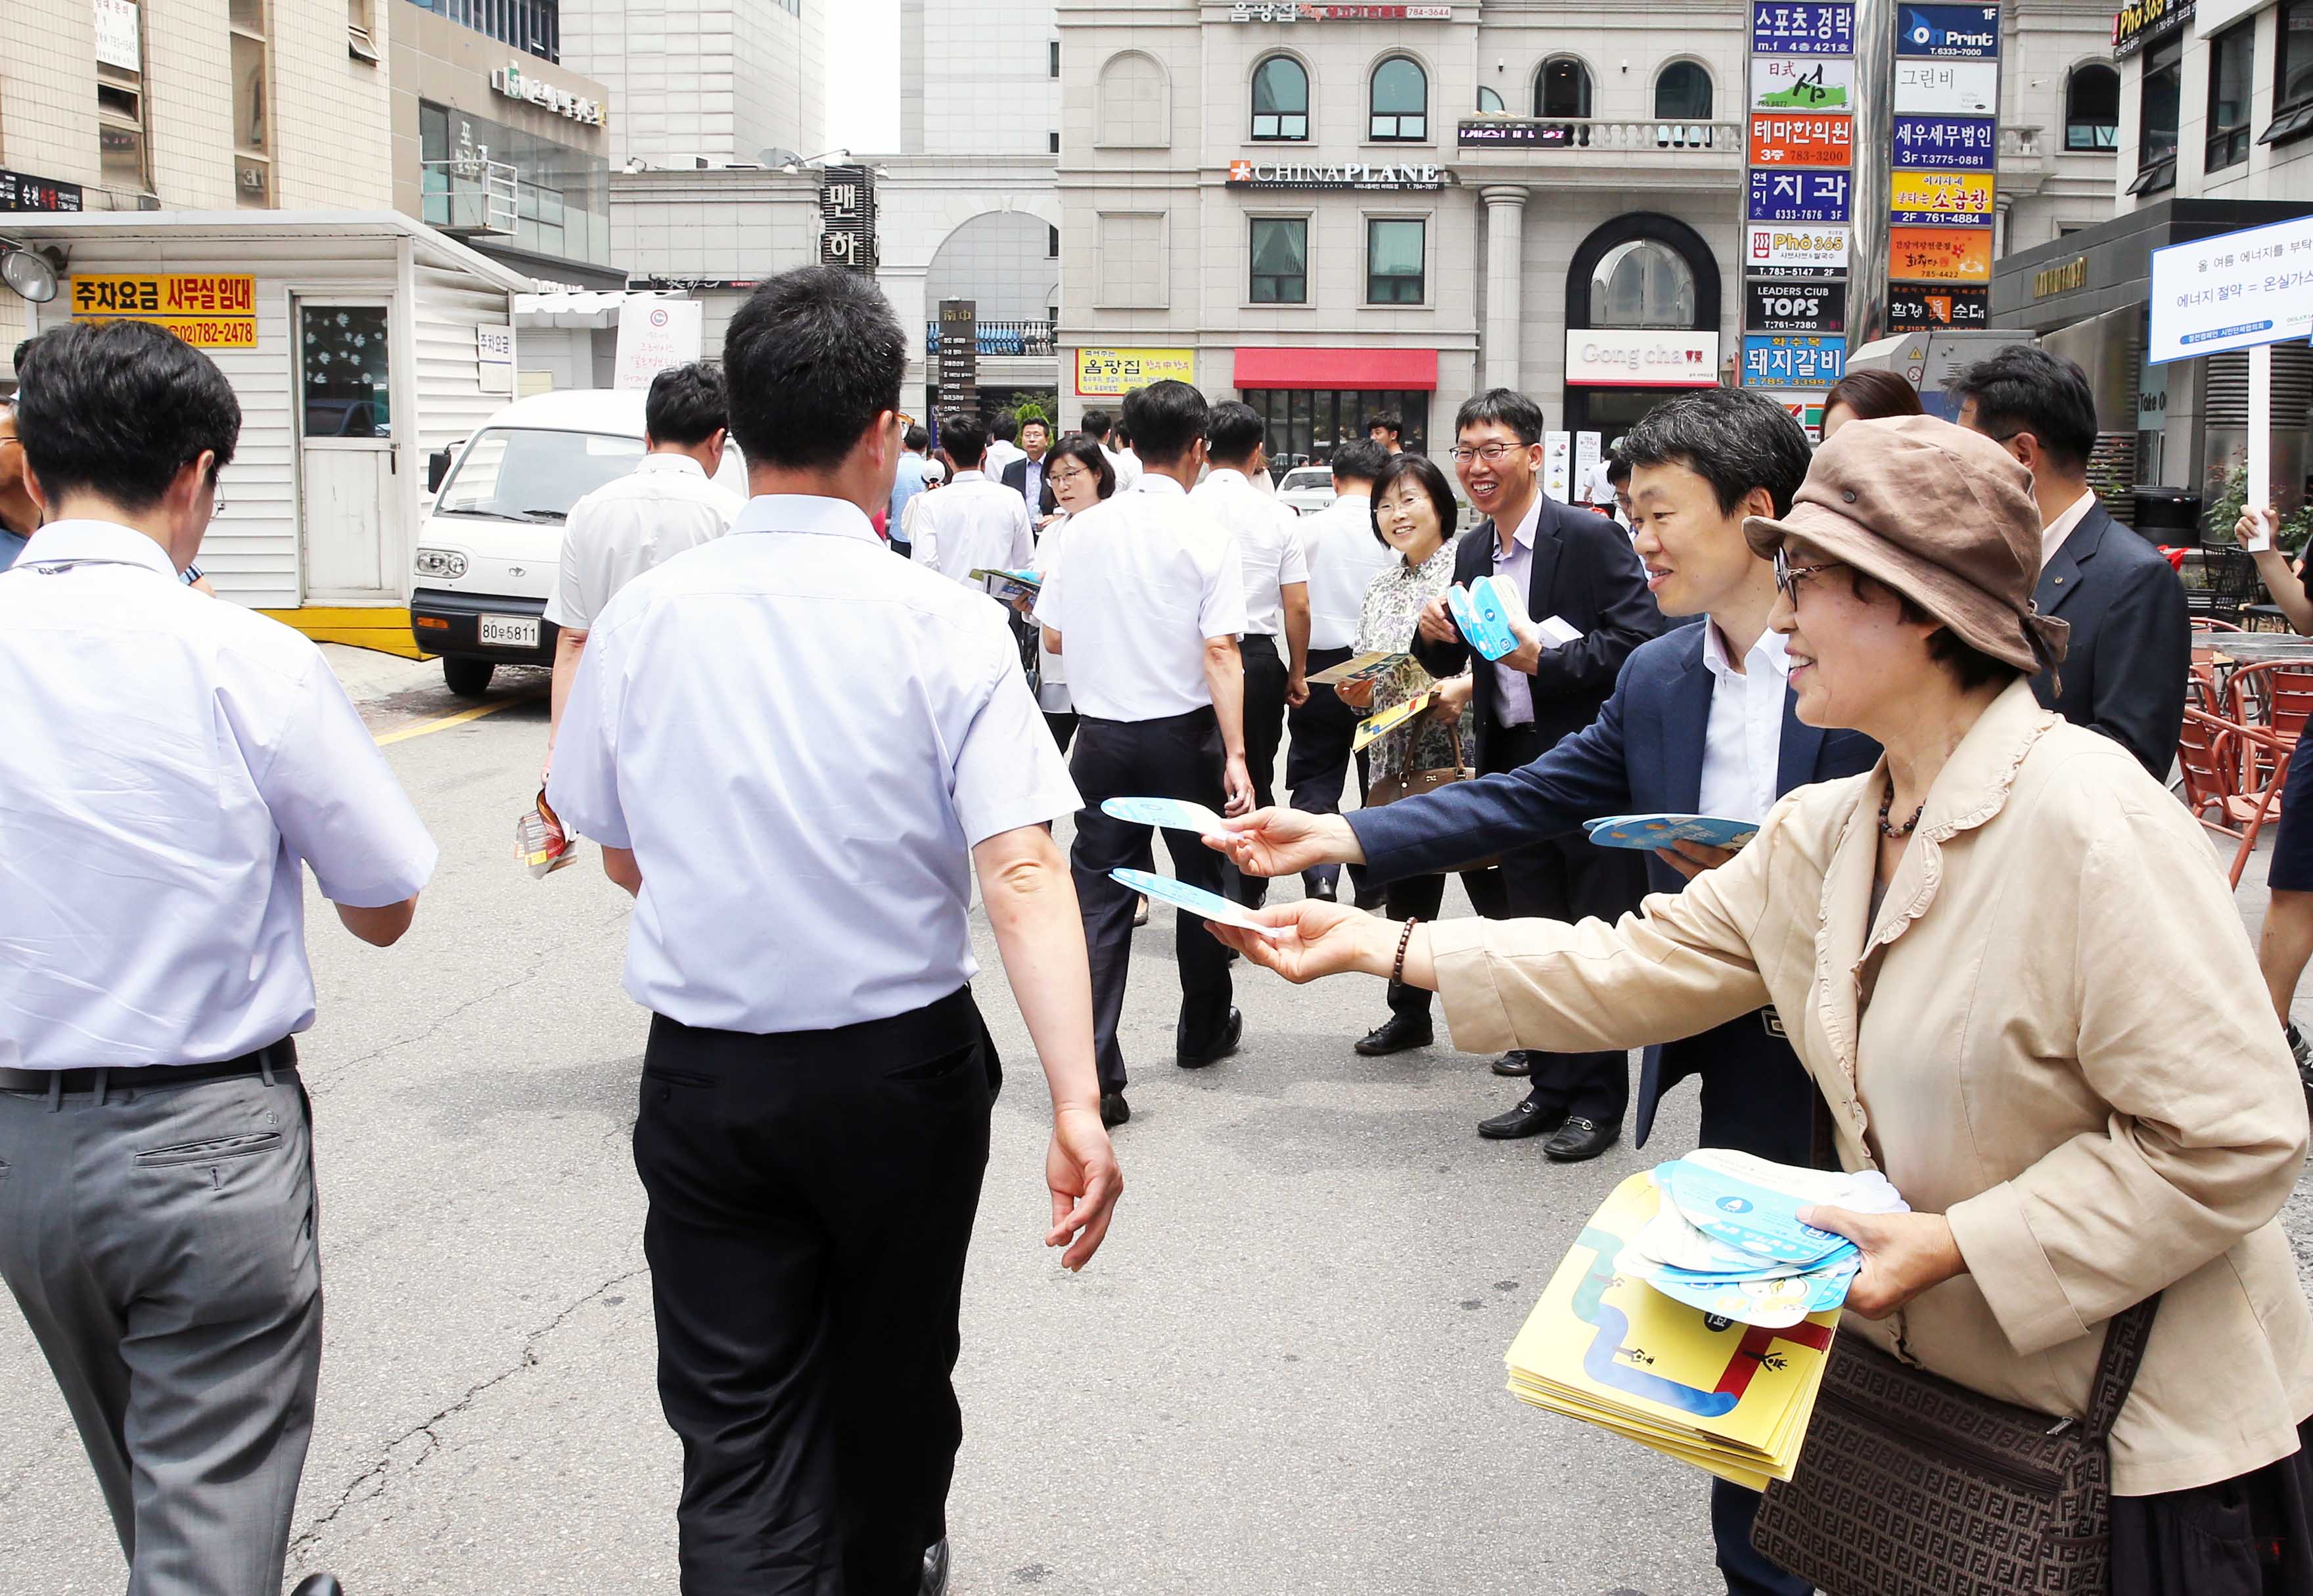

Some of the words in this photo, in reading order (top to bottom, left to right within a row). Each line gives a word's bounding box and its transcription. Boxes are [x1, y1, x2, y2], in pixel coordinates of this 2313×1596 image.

[1230, 1, 1296, 22] 옴팡집
[1408, 7, 1450, 16] 784-3644
[1982, 8, 1996, 20] 1F
[1755, 7, 1852, 40] 스포츠.경락
[1758, 41, 1779, 51] m.f
[1789, 42, 1811, 52] 4층
[1813, 43, 1850, 53] 421호
[1929, 47, 1982, 56] T.6333-7000
[1770, 60, 1796, 78] 日式
[1900, 68, 1954, 90] 그린비
[1754, 120, 1850, 145] 테마한의원
[1896, 123, 1992, 148] 세우세무법인
[1760, 148, 1785, 161] 3층
[1790, 150, 1843, 162] 783-3200
[1902, 150, 1919, 164] 3F
[1921, 154, 1984, 165] T.3775-0881
[1752, 172, 1767, 205] 연이
[1773, 175, 1847, 205] 치과
[1932, 188, 1988, 211] 소곱창
[1775, 209, 1822, 219] 6333-7676
[1830, 210, 1843, 220] 3F
[1902, 212, 1917, 222] 2F
[1925, 213, 1980, 223] 761-4884
[1814, 237, 1844, 251] 365
[2197, 260, 2209, 273] 올
[2213, 254, 2235, 268] 여름
[2239, 244, 2284, 263] 에너지를
[1759, 267, 1766, 275] T.
[1768, 267, 1814, 277] 783-5147
[1823, 268, 1835, 277] 2F
[1921, 270, 1959, 279] 785-4422
[76, 281, 159, 311] 주차요금
[167, 278, 216, 310] 사무실
[218, 277, 251, 310] 임대
[1757, 286, 1802, 296] LEADERS
[2176, 288, 2214, 308] 에너지
[2218, 283, 2243, 301] 절약
[1762, 298, 1819, 317] TOPS
[1952, 303, 1985, 319] 순대
[480, 334, 509, 355] 주차요금
[1581, 343, 1641, 370] Gong
[1645, 344, 1683, 365] cha
[1747, 348, 1841, 377] 돼지갈비
[1084, 359, 1140, 375] 옴팡집
[2139, 392, 2157, 412] Take
[482, 624, 536, 642] 80우5811
